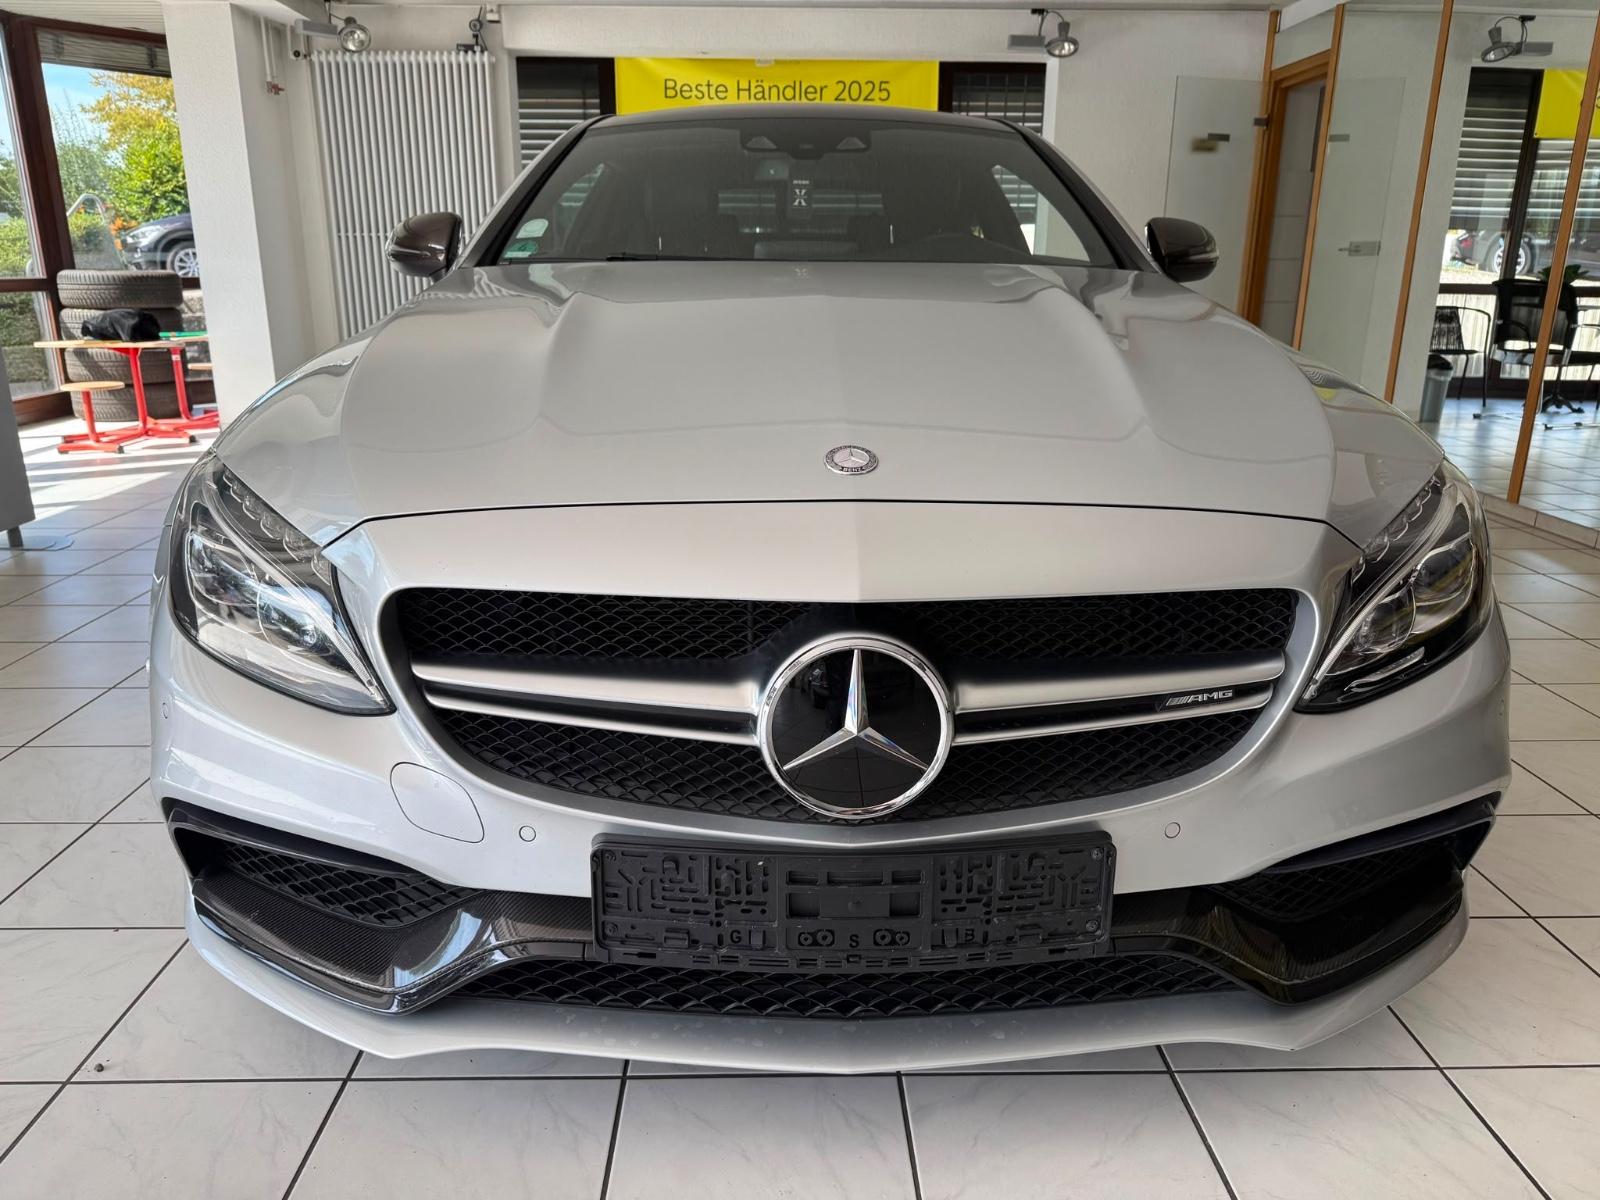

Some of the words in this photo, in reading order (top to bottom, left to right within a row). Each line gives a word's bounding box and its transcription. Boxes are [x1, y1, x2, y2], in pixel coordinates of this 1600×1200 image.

[664, 78, 728, 101] Beste
[737, 79, 828, 102] Händler
[834, 80, 891, 102] 2025
[729, 930, 743, 944] G
[848, 934, 860, 949] S
